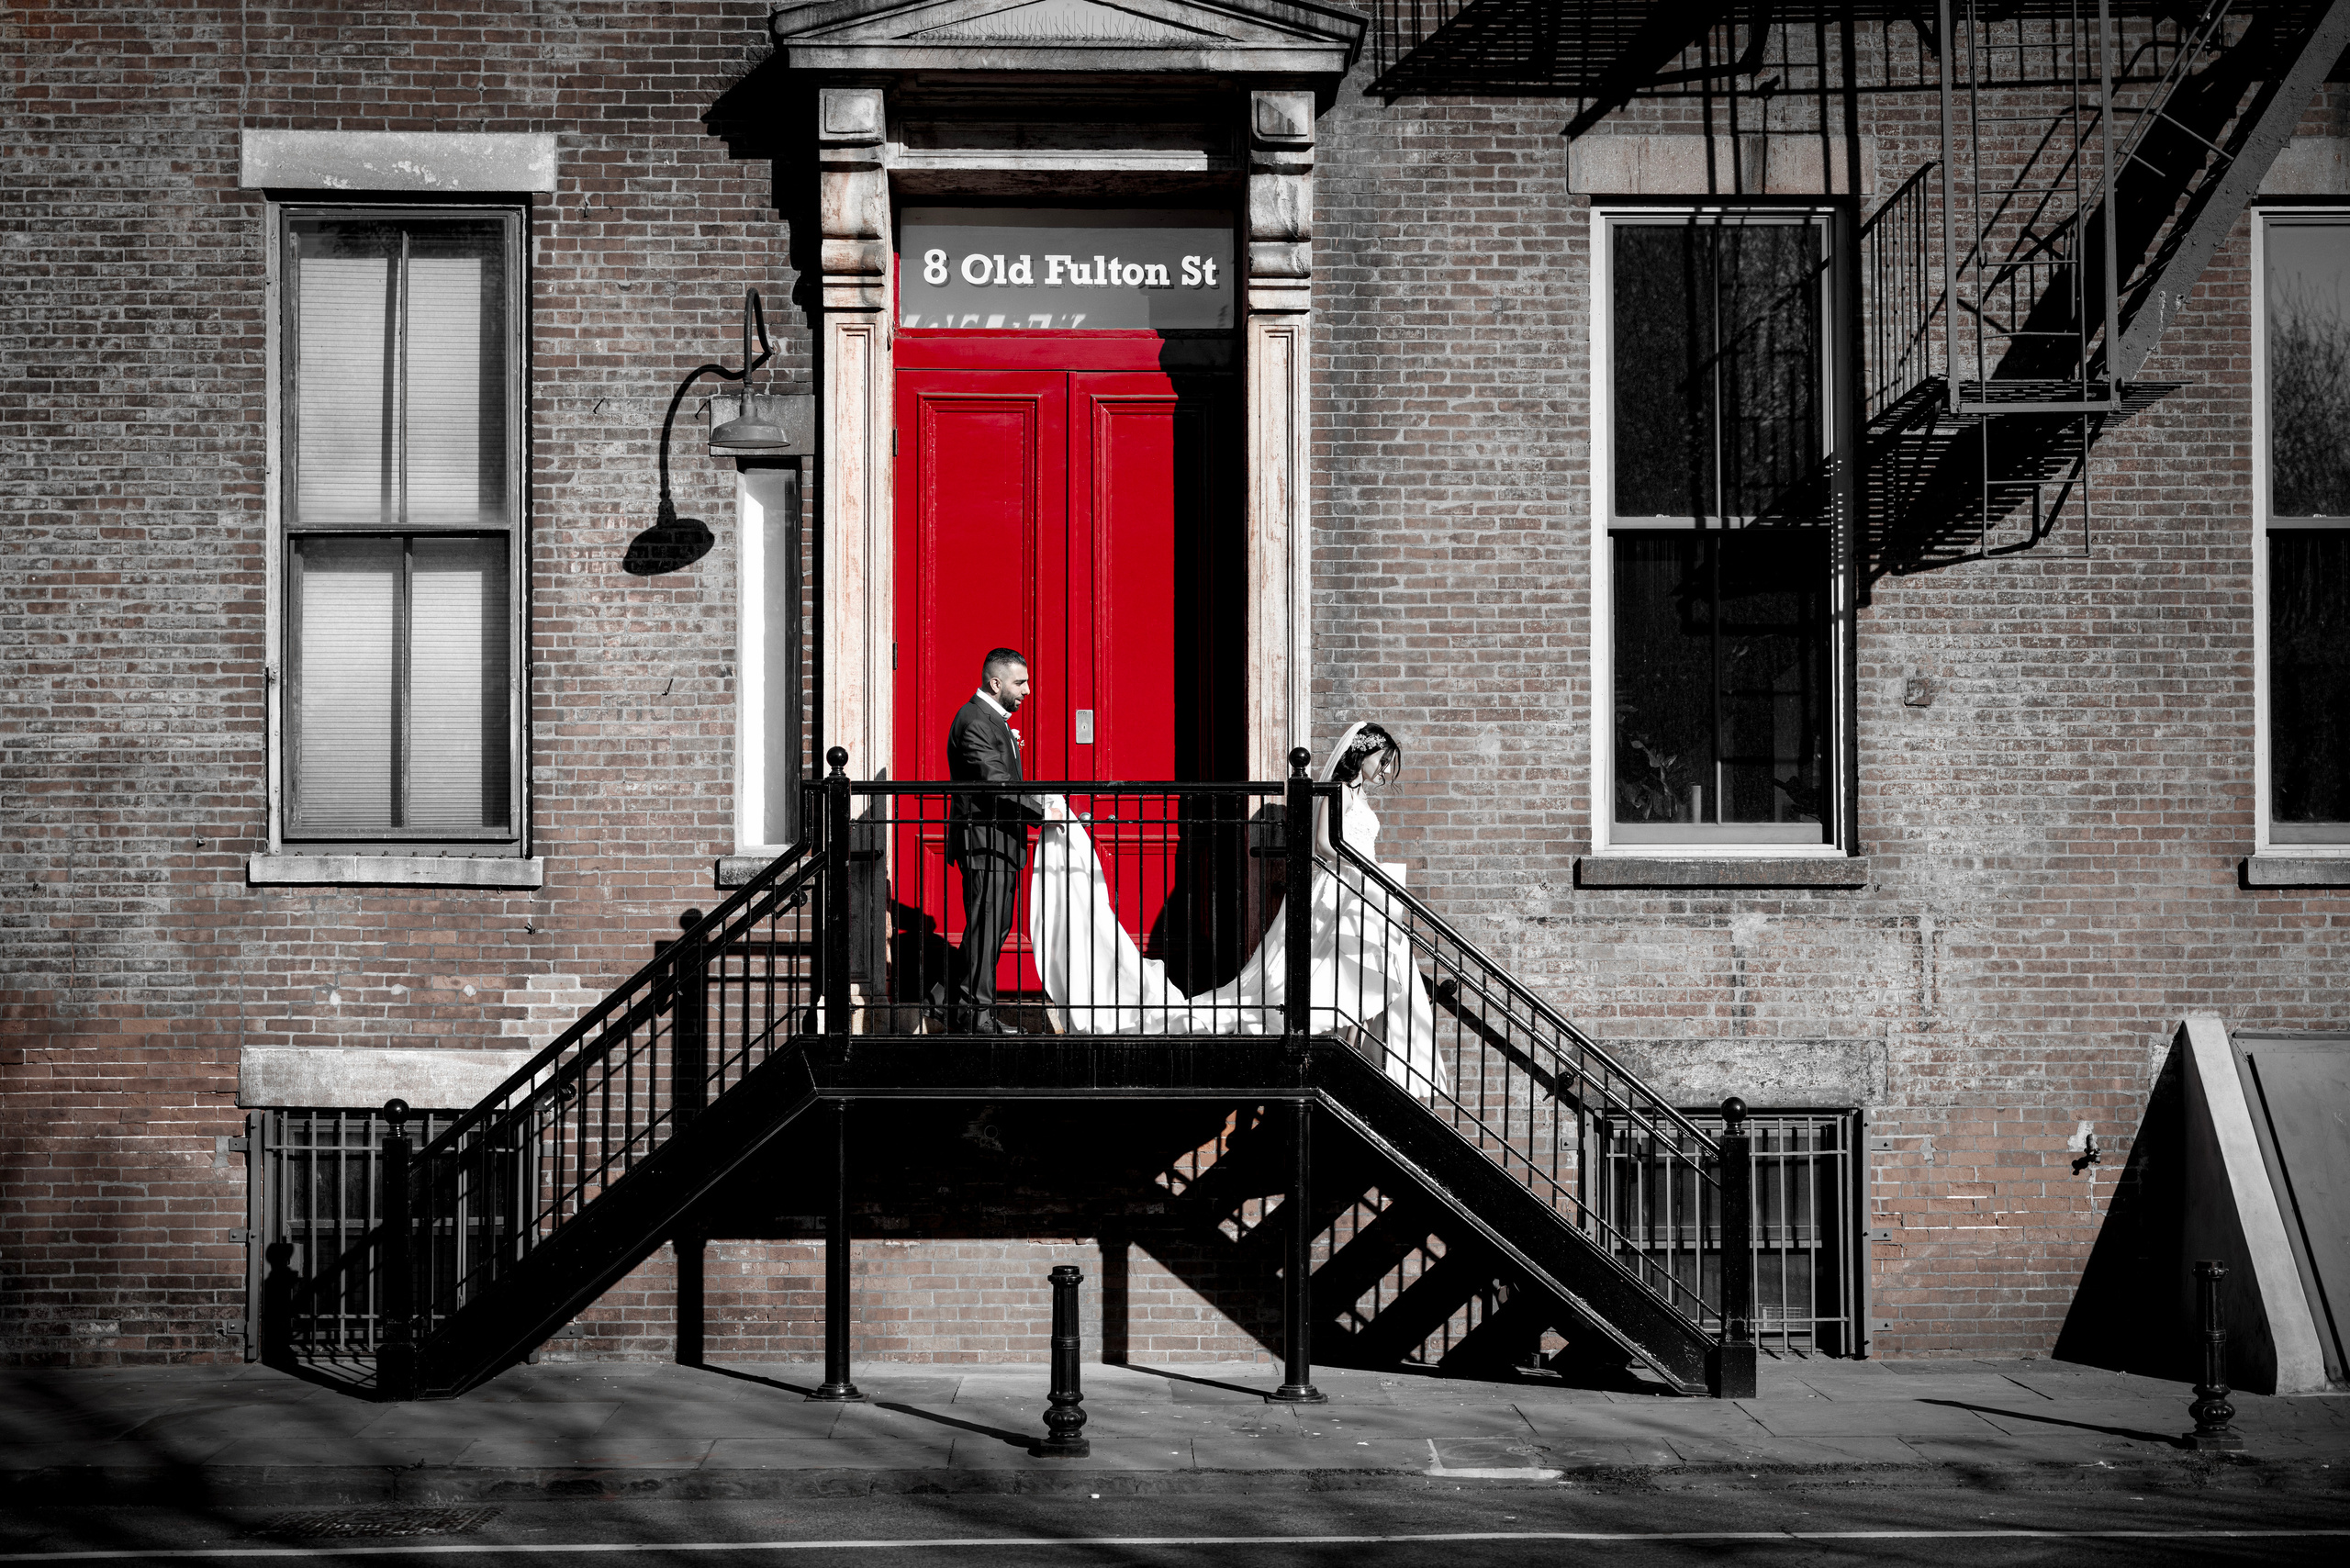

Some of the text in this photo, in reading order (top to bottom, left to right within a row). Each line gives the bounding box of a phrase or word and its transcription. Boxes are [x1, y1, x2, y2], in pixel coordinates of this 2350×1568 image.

[923, 249, 1217, 286] 8 Old Fulton St
